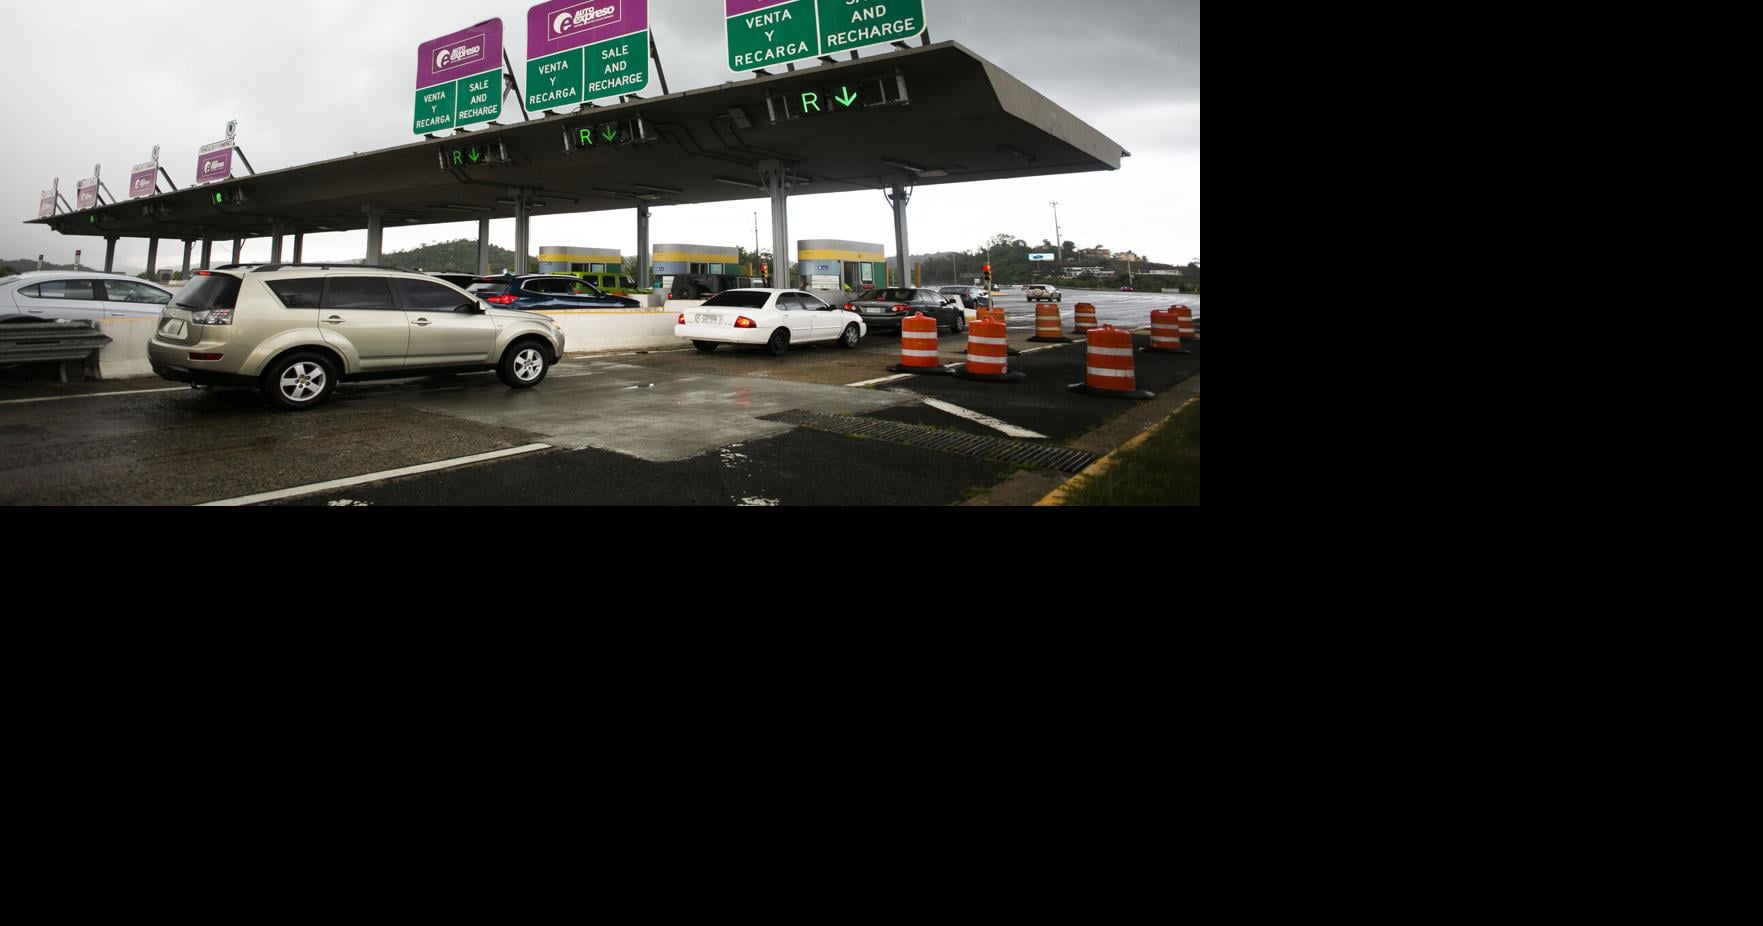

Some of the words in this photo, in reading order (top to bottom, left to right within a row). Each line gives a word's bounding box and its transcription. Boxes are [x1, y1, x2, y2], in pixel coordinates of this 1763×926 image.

[573, 5, 614, 25] expreso
[746, 9, 792, 29] VENTA
[851, 5, 886, 23] AND
[765, 30, 775, 42] Y
[827, 18, 916, 47] RECHARGE
[601, 45, 629, 60] SALE
[734, 41, 809, 66] RECARGA
[538, 60, 569, 75] VENTA
[604, 61, 627, 75] AND
[469, 80, 489, 92] SALE
[549, 77, 557, 86] Y
[588, 73, 643, 93] RECHARGE
[424, 91, 446, 103] VENTA
[471, 92, 487, 105] AND
[529, 87, 576, 105] RECARGA
[801, 92, 821, 113] R
[432, 104, 437, 113] Y
[458, 104, 498, 120] RECHARGE
[416, 114, 450, 129] RECARGA
[579, 128, 593, 145] R
[453, 150, 463, 165] R
